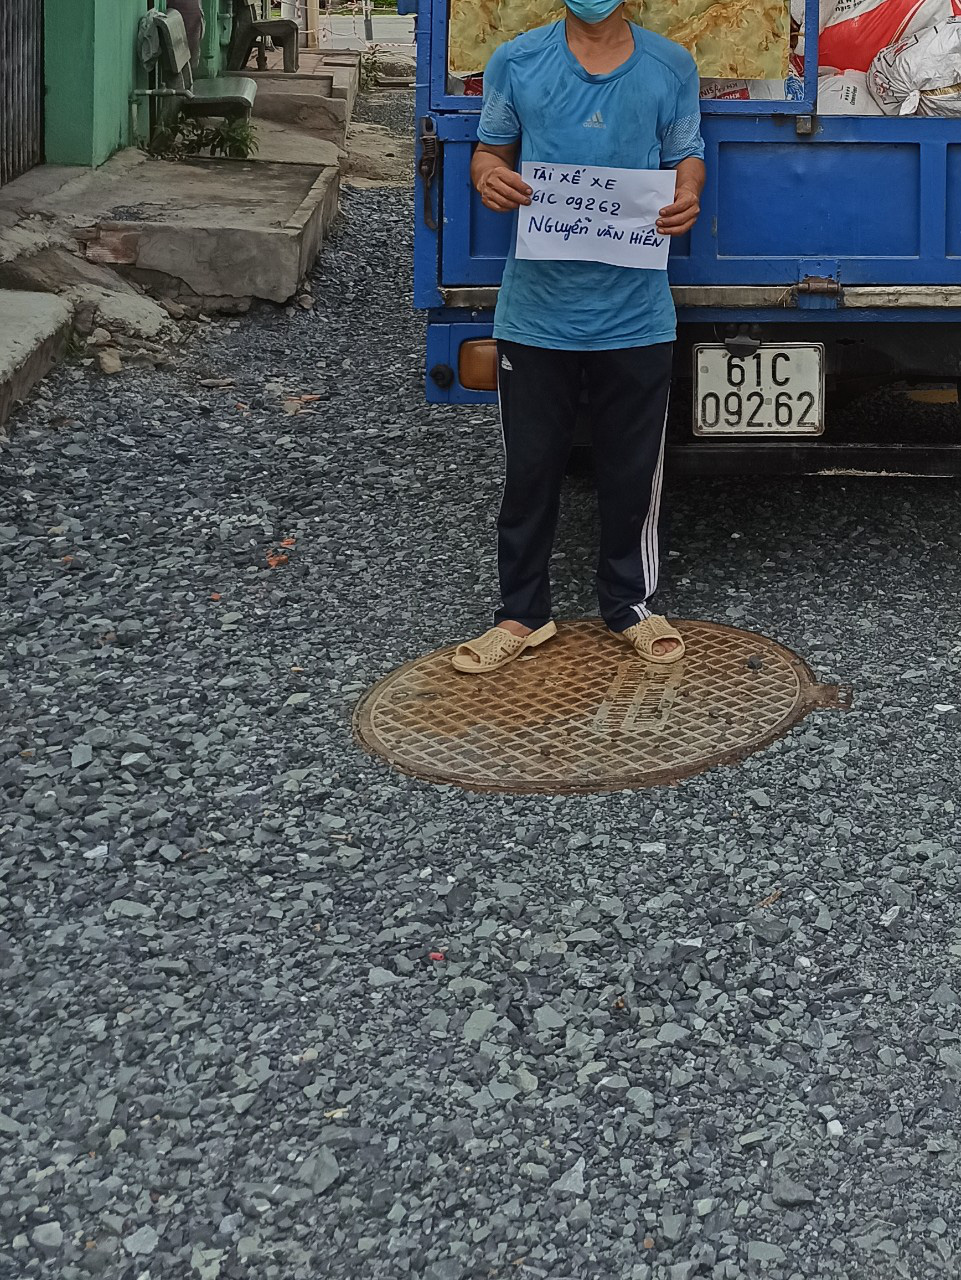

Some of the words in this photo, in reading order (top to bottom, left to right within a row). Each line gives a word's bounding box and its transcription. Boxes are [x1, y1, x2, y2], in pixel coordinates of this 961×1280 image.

[590, 177, 617, 190] XE
[532, 189, 558, 205] 61C
[565, 196, 621, 216] 09262
[726, 352, 791, 388] 61C
[700, 391, 816, 428] 092.62
